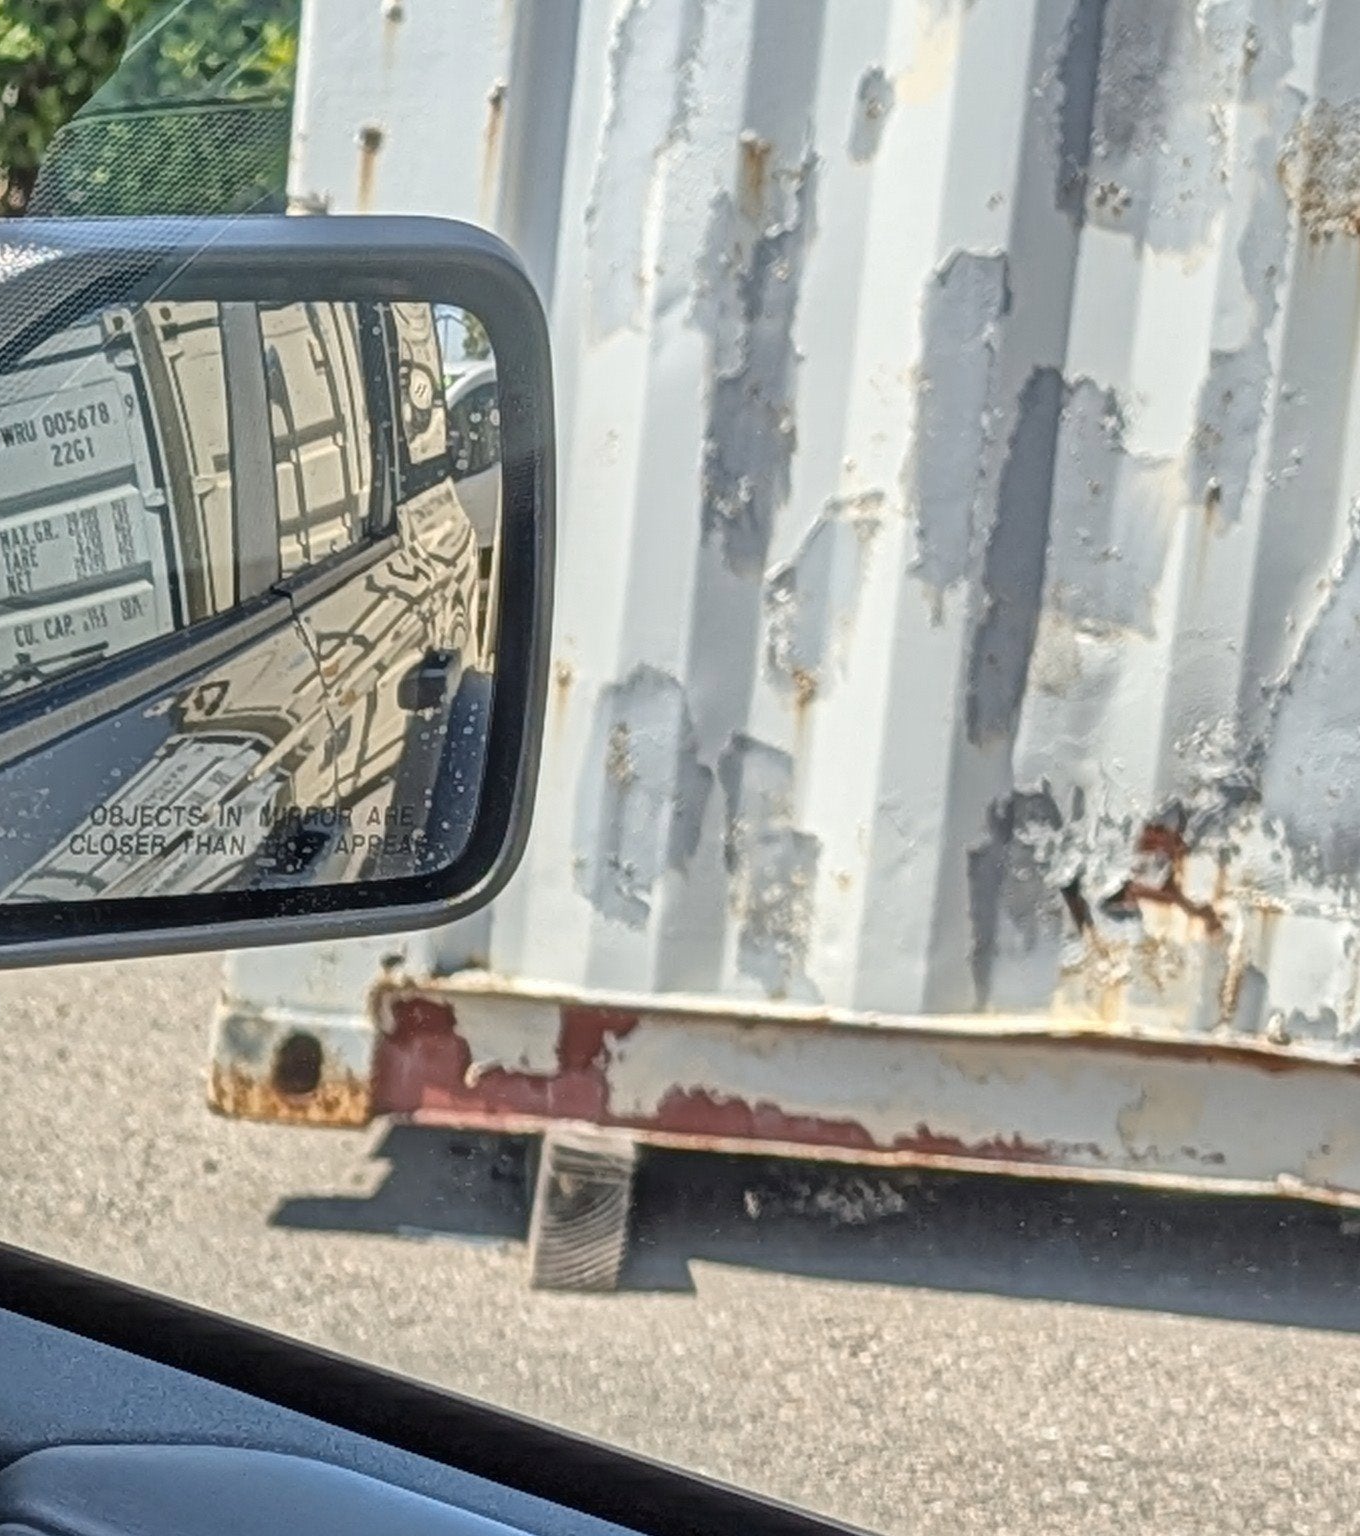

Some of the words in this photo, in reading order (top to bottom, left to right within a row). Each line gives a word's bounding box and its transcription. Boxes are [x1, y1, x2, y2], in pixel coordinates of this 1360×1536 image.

[42, 402, 110, 438] 005678
[44, 614, 76, 640] CAP.
[91, 805, 205, 828] OBJECTS
[218, 806, 243, 828] IN
[366, 805, 415, 826] ARE
[69, 834, 166, 857] CLOSER
[183, 834, 246, 857] THAN
